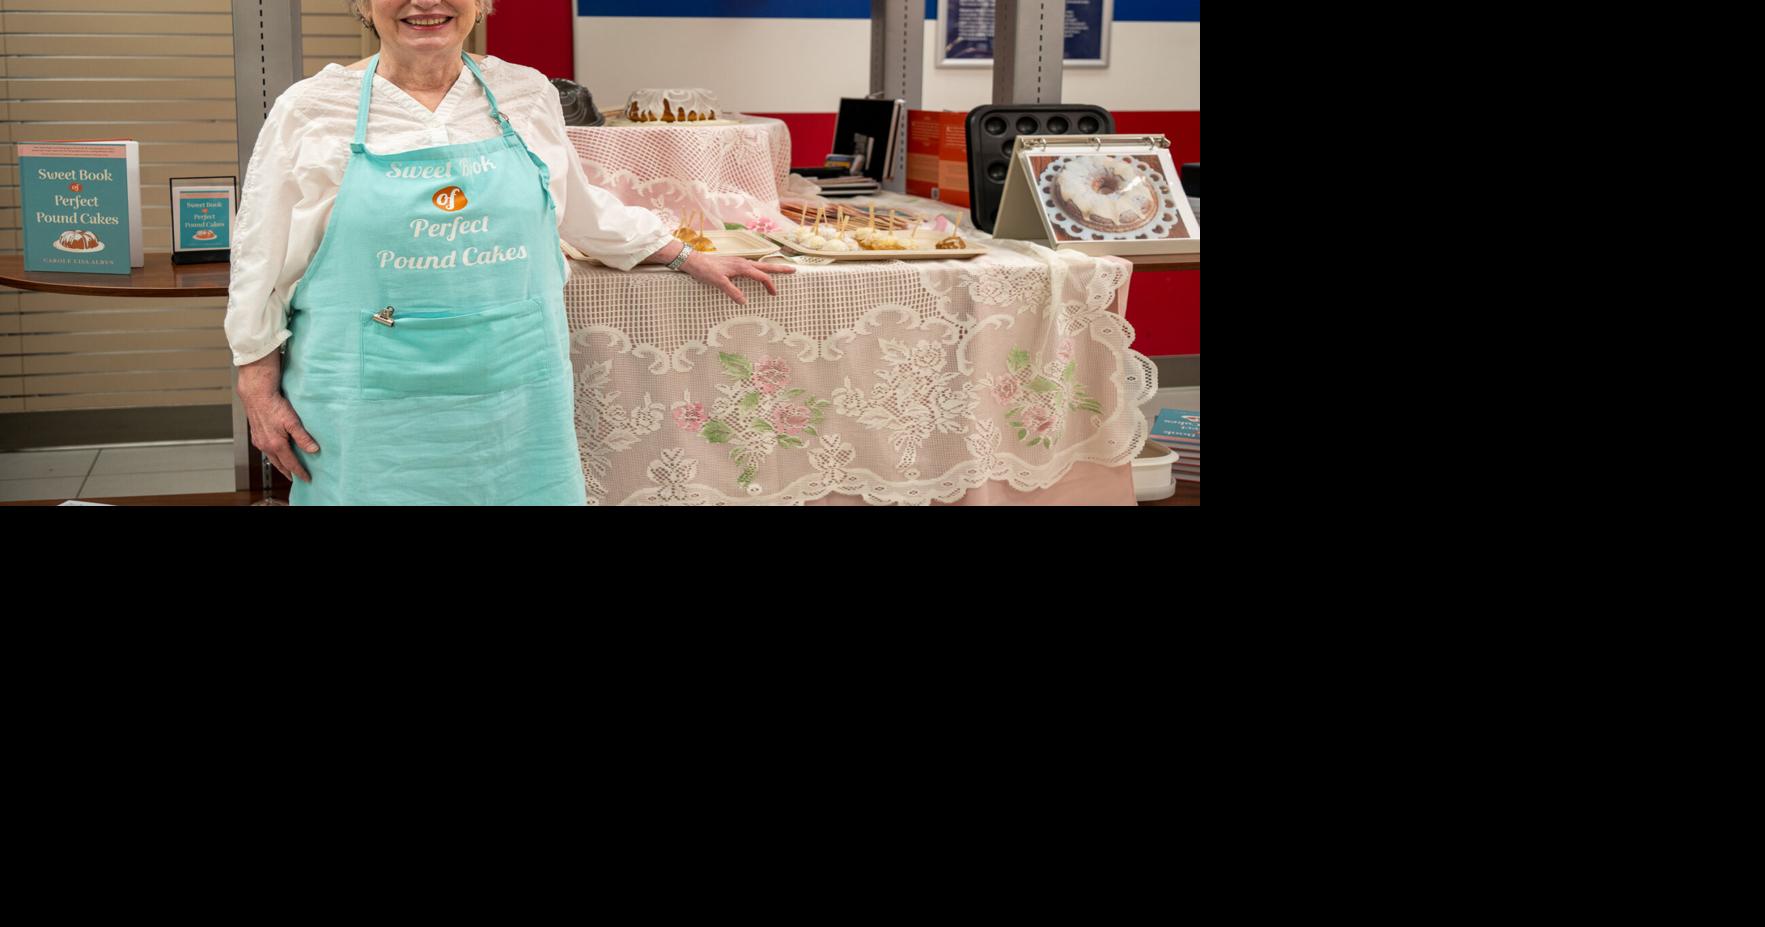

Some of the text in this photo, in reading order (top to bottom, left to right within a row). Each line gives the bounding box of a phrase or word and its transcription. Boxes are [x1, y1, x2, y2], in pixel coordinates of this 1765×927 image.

[38, 168, 113, 181] Sweet Book
[386, 161, 452, 179] Sweet
[71, 183, 80, 192] of
[54, 194, 99, 209] Perfect
[436, 188, 460, 210] of
[36, 212, 119, 225] Pound Cakes
[410, 216, 489, 241] Perfect
[376, 245, 528, 269] Pound Cakes
